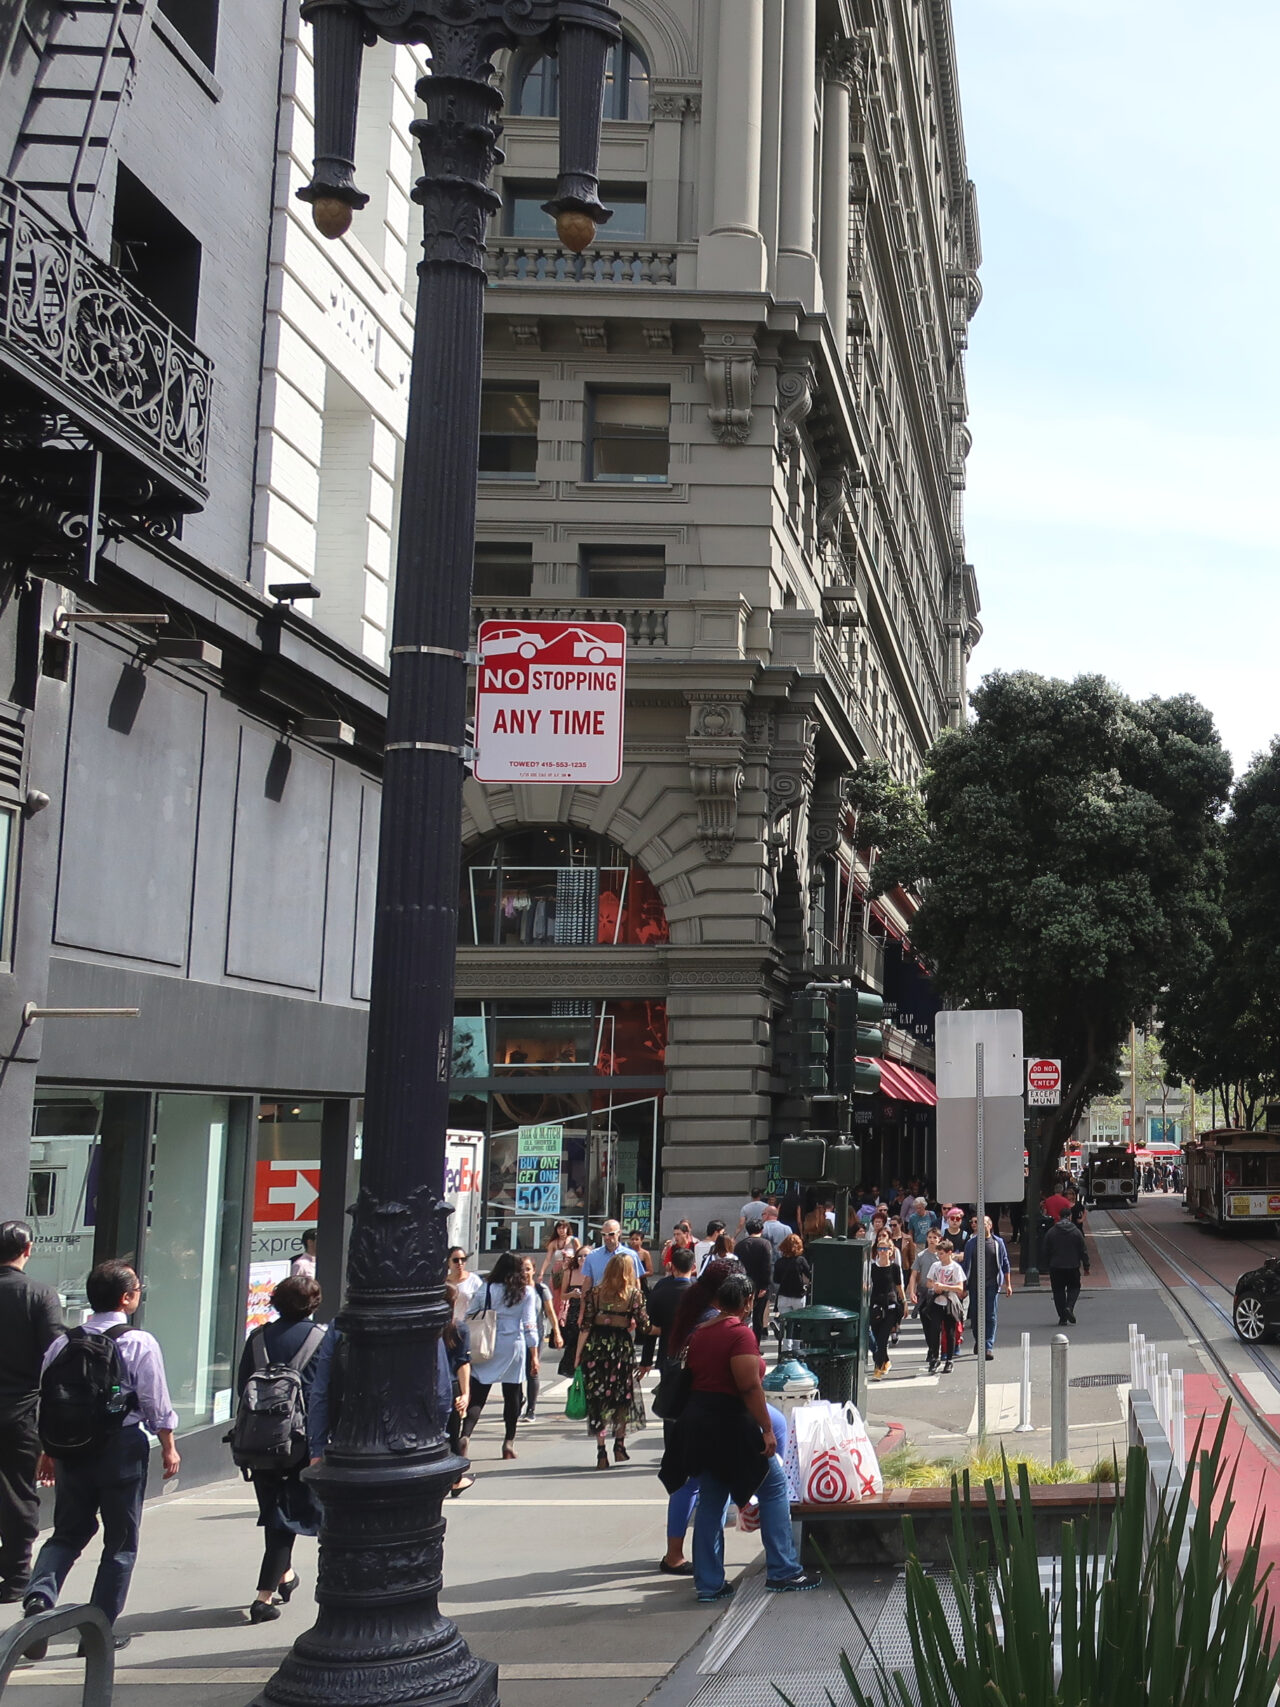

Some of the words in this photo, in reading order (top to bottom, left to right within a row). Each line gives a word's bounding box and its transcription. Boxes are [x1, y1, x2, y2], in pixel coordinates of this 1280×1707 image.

[484, 668, 525, 690] NO
[532, 670, 616, 691] STOPPING
[493, 709, 542, 735] ANY
[549, 710, 605, 735] TIME
[900, 1014, 914, 1024] GAP
[915, 1025, 928, 1034] GAP
[520, 1156, 539, 1169] BUY
[540, 1156, 560, 1169] ONE
[519, 1169, 539, 1183] GET
[540, 1169, 559, 1182] ONE
[542, 1201, 557, 1212] OFF
[624, 1201, 637, 1210] BUY
[637, 1201, 650, 1209] ONE
[637, 1209, 650, 1217] ONE
[250, 1233, 303, 1256] Expre
